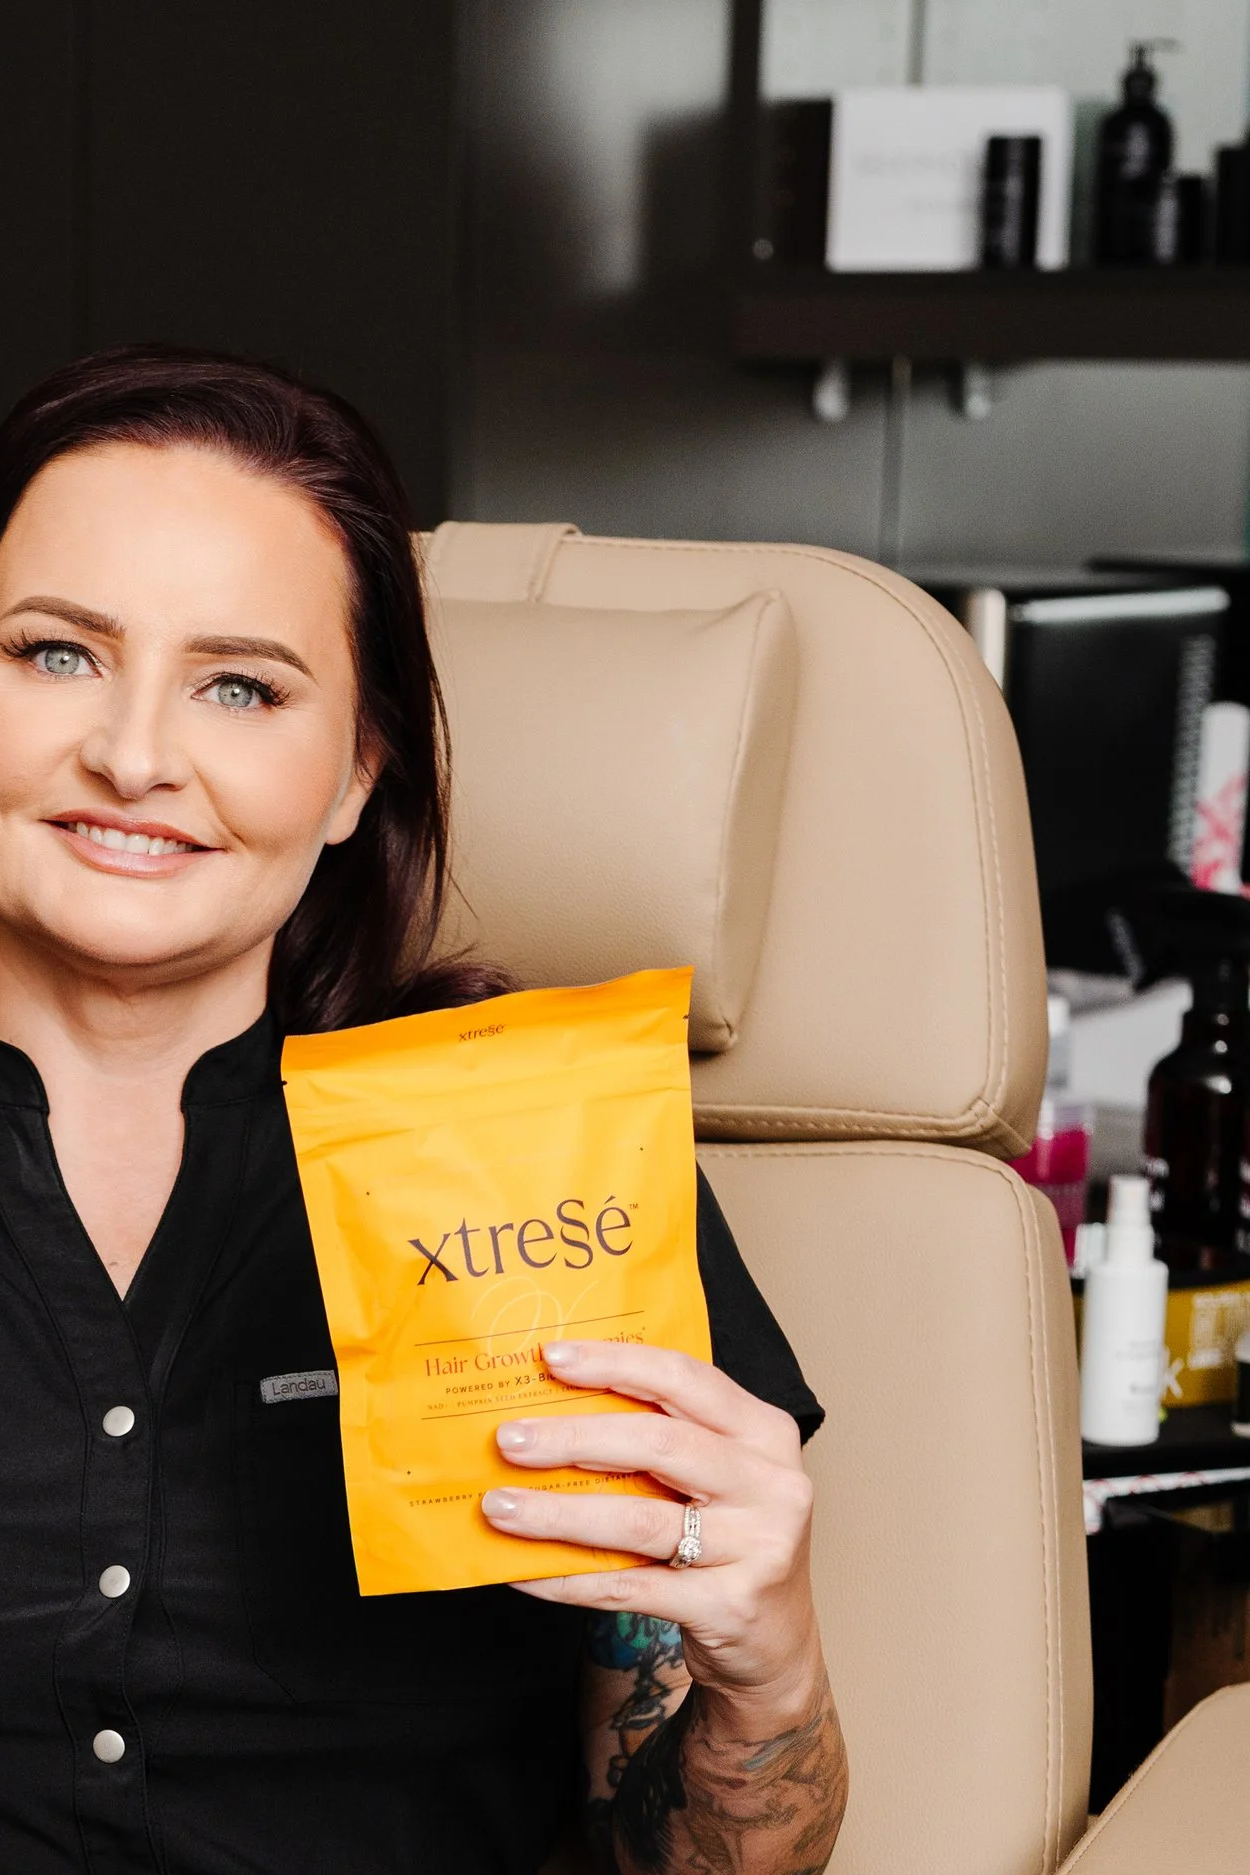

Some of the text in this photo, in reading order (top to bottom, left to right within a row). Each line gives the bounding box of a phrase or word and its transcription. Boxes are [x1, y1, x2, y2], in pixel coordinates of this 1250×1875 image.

[425, 1356, 468, 1377] Hair
[272, 1379, 326, 1396] Landau
[446, 1382, 493, 1394] POWERED
[499, 1380, 510, 1388] BY
[409, 1493, 474, 1508] STRAWBERRY
